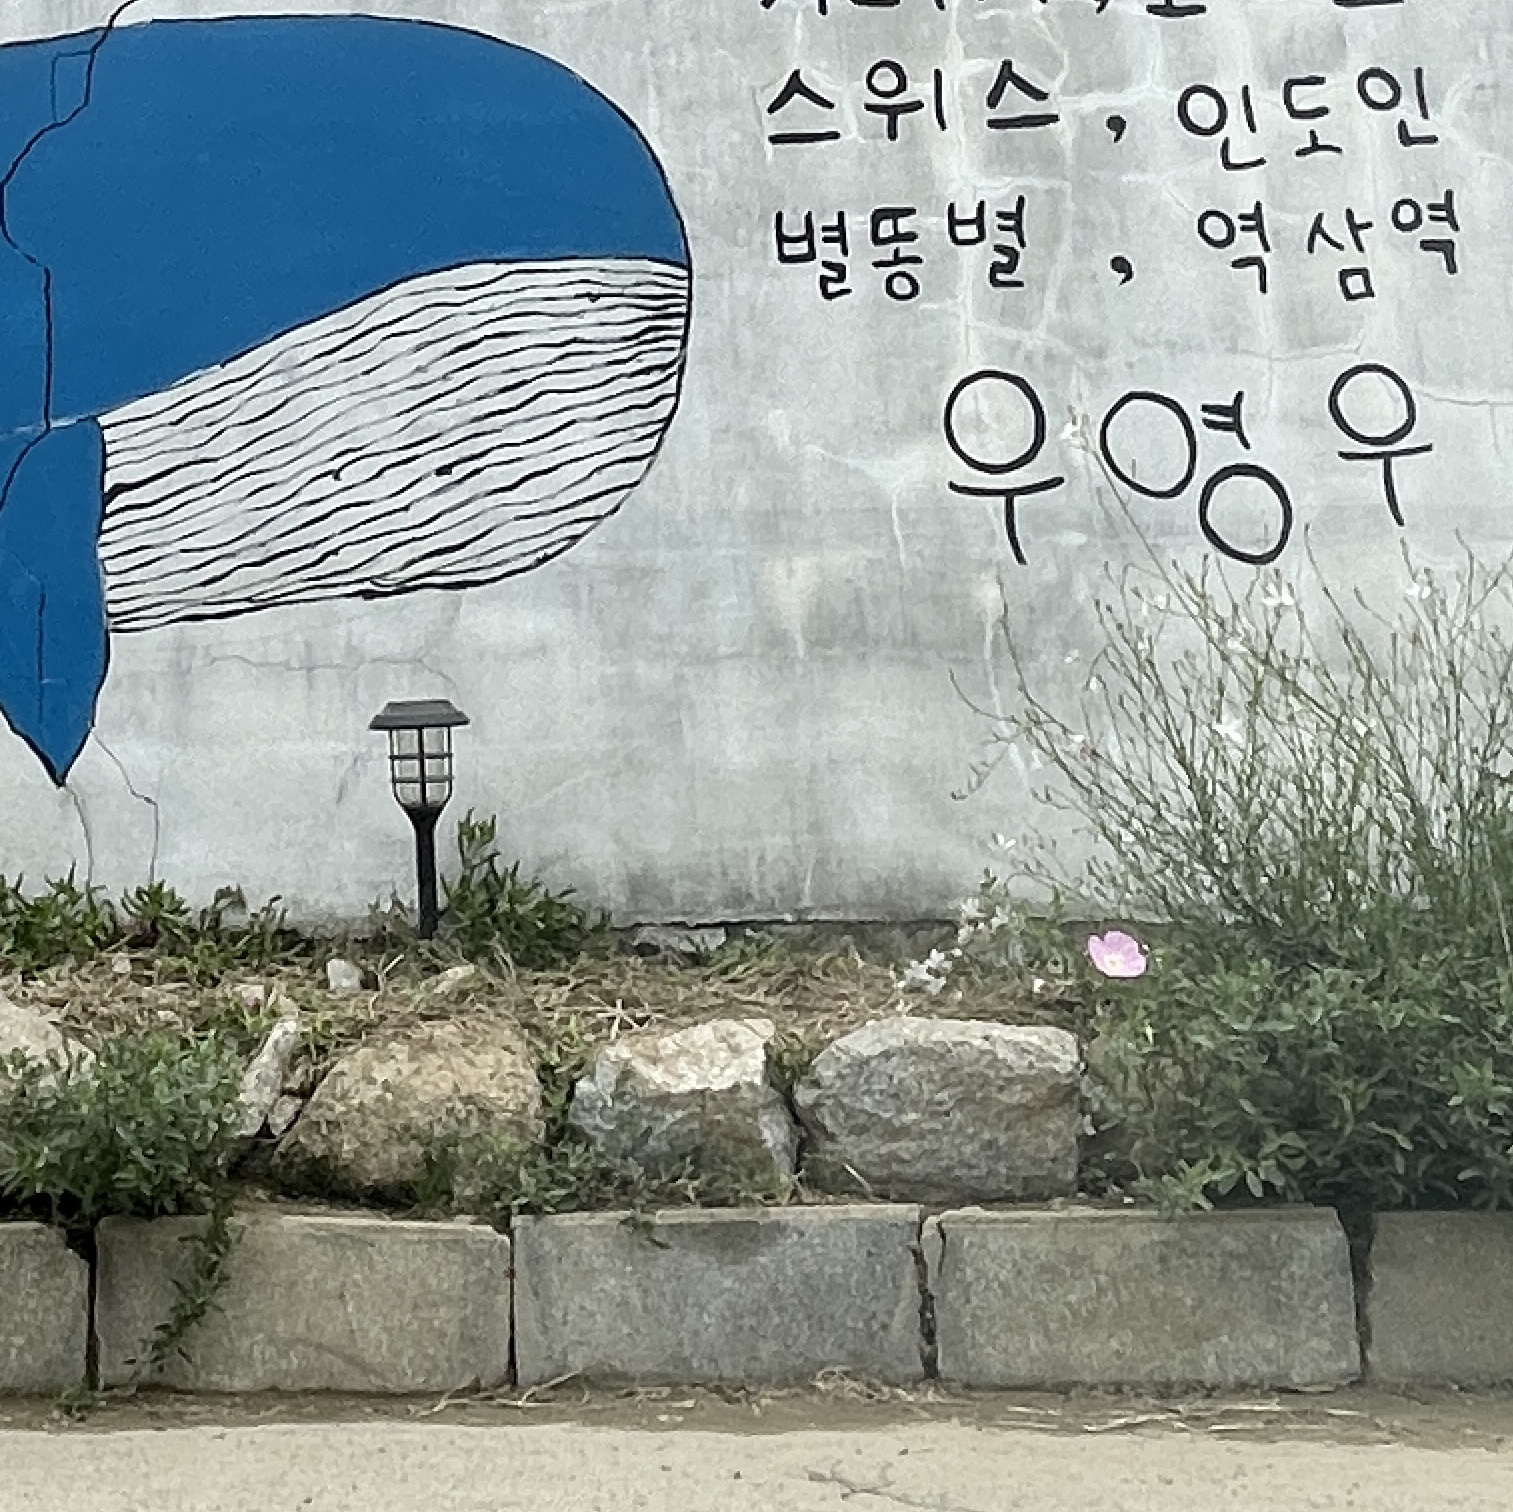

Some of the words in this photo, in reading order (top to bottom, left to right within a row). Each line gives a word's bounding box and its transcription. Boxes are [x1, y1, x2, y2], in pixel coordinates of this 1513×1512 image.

[1177, 66, 1439, 171] 인도인
[1197, 190, 1460, 302] 역삼역
[943, 364, 1433, 566] 우영우
